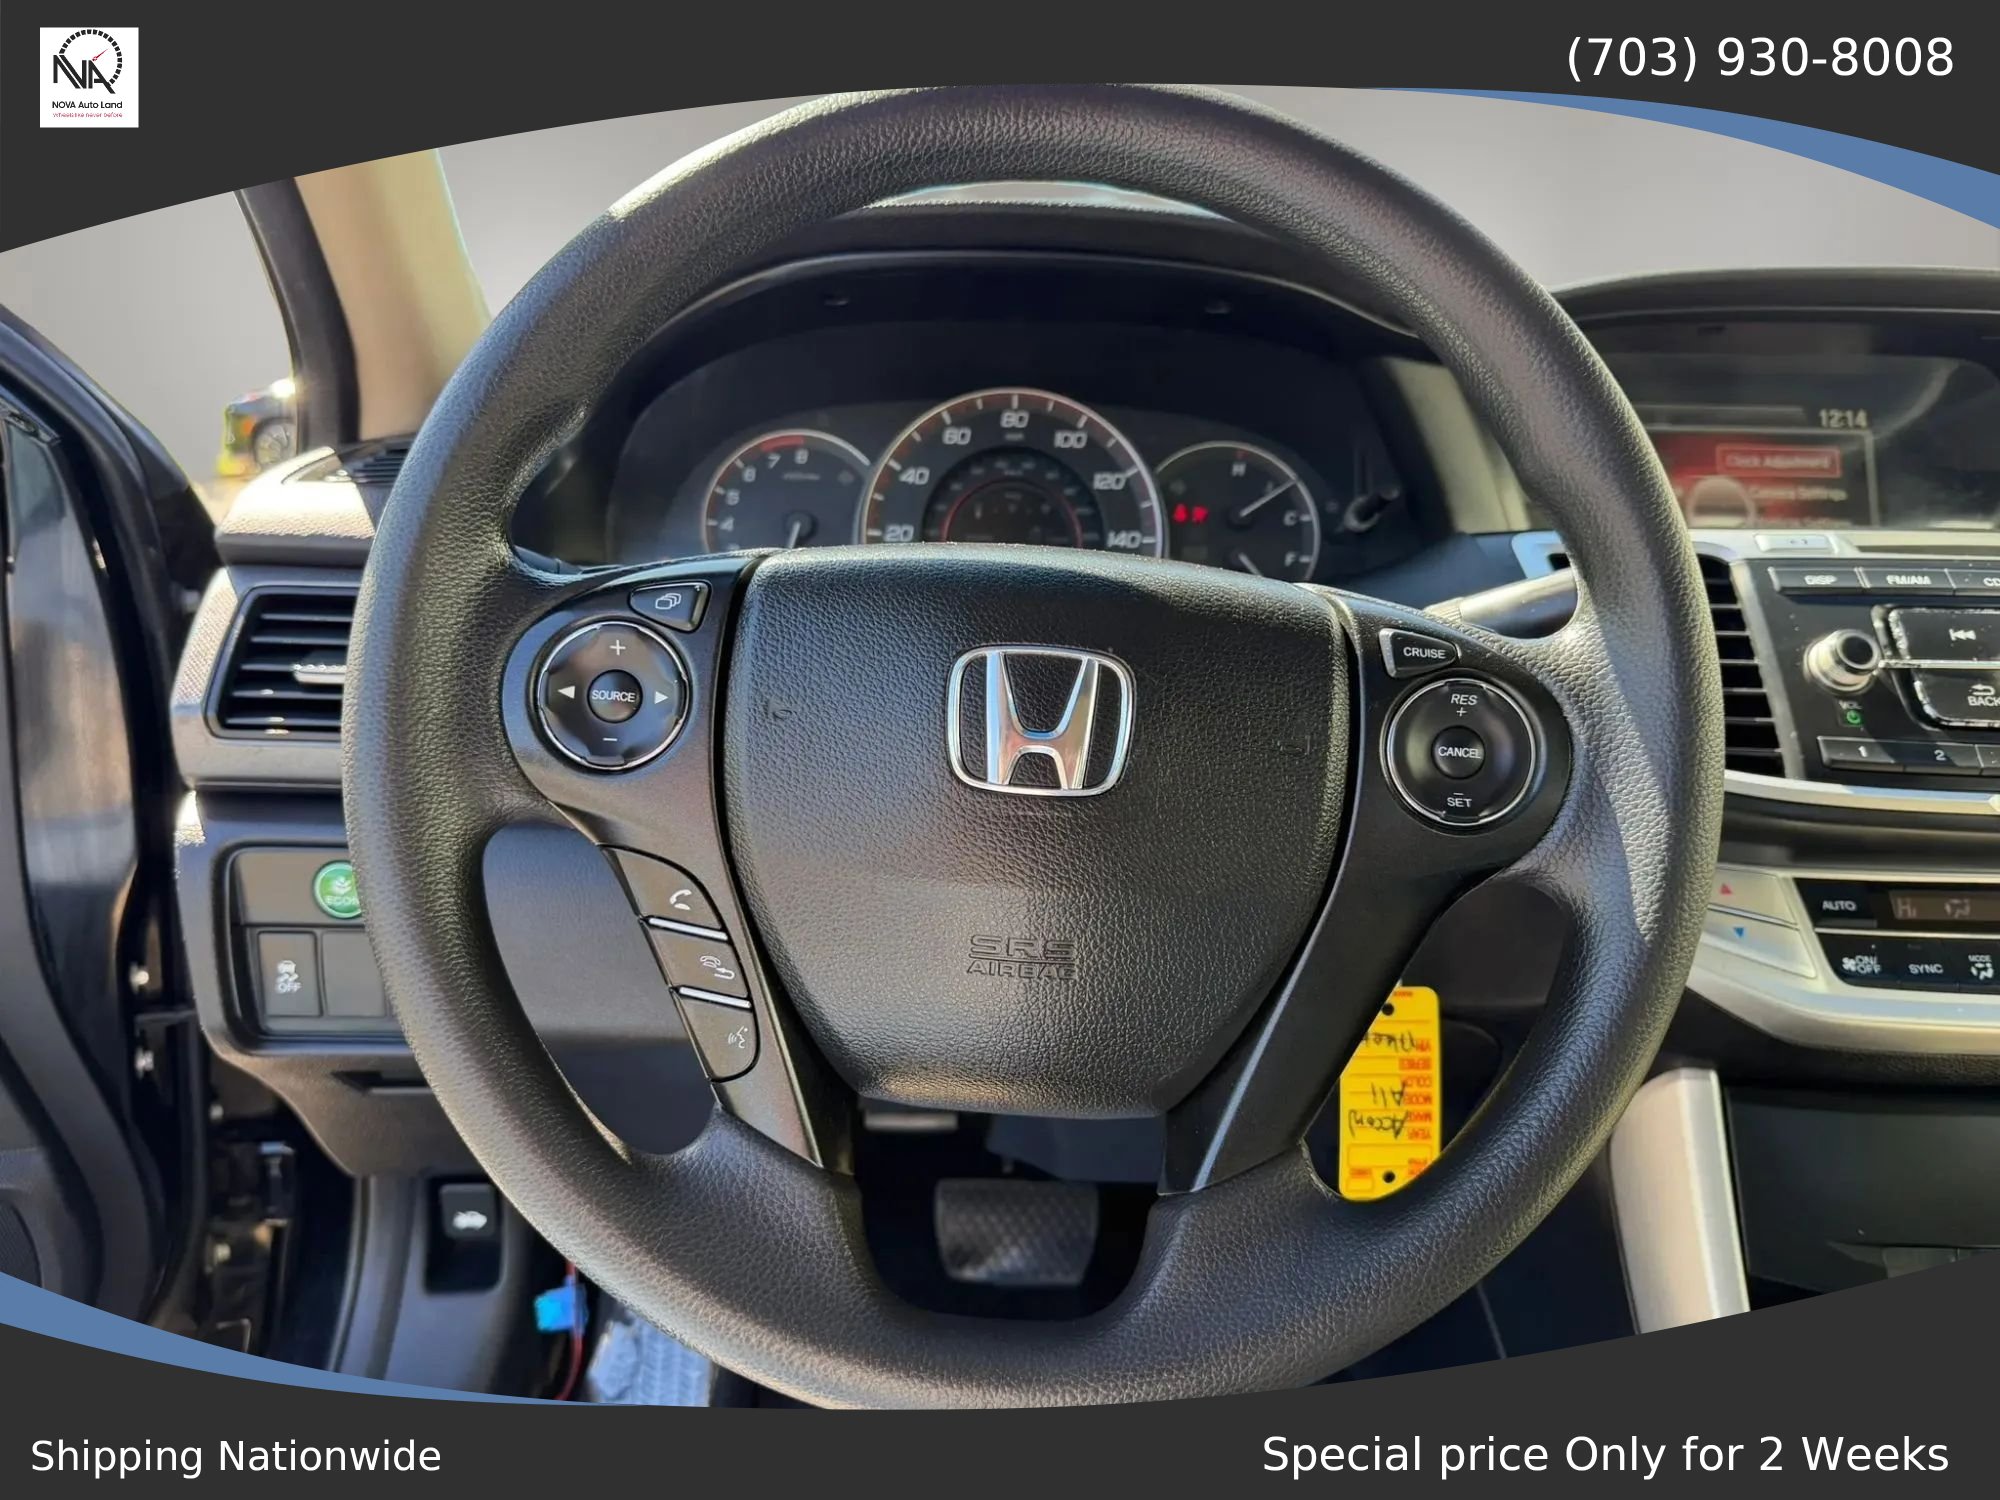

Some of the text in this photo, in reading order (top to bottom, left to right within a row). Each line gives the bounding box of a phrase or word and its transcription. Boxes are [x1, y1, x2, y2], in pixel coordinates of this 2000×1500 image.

[1000, 411, 1029, 428] 80
[942, 427, 972, 445] 60
[1053, 431, 1088, 449] 100
[768, 454, 781, 468] 7
[900, 467, 930, 485] 40
[1093, 472, 1127, 490] 120
[719, 517, 734, 531] 4
[885, 524, 914, 541] 20
[1107, 531, 1142, 548] 140
[1285, 551, 1297, 567] F
[1804, 575, 1837, 586] DISP
[1886, 575, 1932, 586] FM/AM
[1403, 647, 1446, 659] CRUISE
[592, 690, 636, 702] SOURCE
[1450, 693, 1478, 706] RES
[1438, 746, 1482, 759] CANCEL
[1858, 745, 1868, 757] 1
[1934, 749, 1947, 761] 2
[1447, 797, 1472, 808] SET
[1822, 900, 1857, 911] AUTO
[969, 934, 1077, 960] SRS
[1856, 964, 1882, 974] OFF
[1908, 964, 1944, 974] SYNC
[276, 982, 302, 994] OFF
